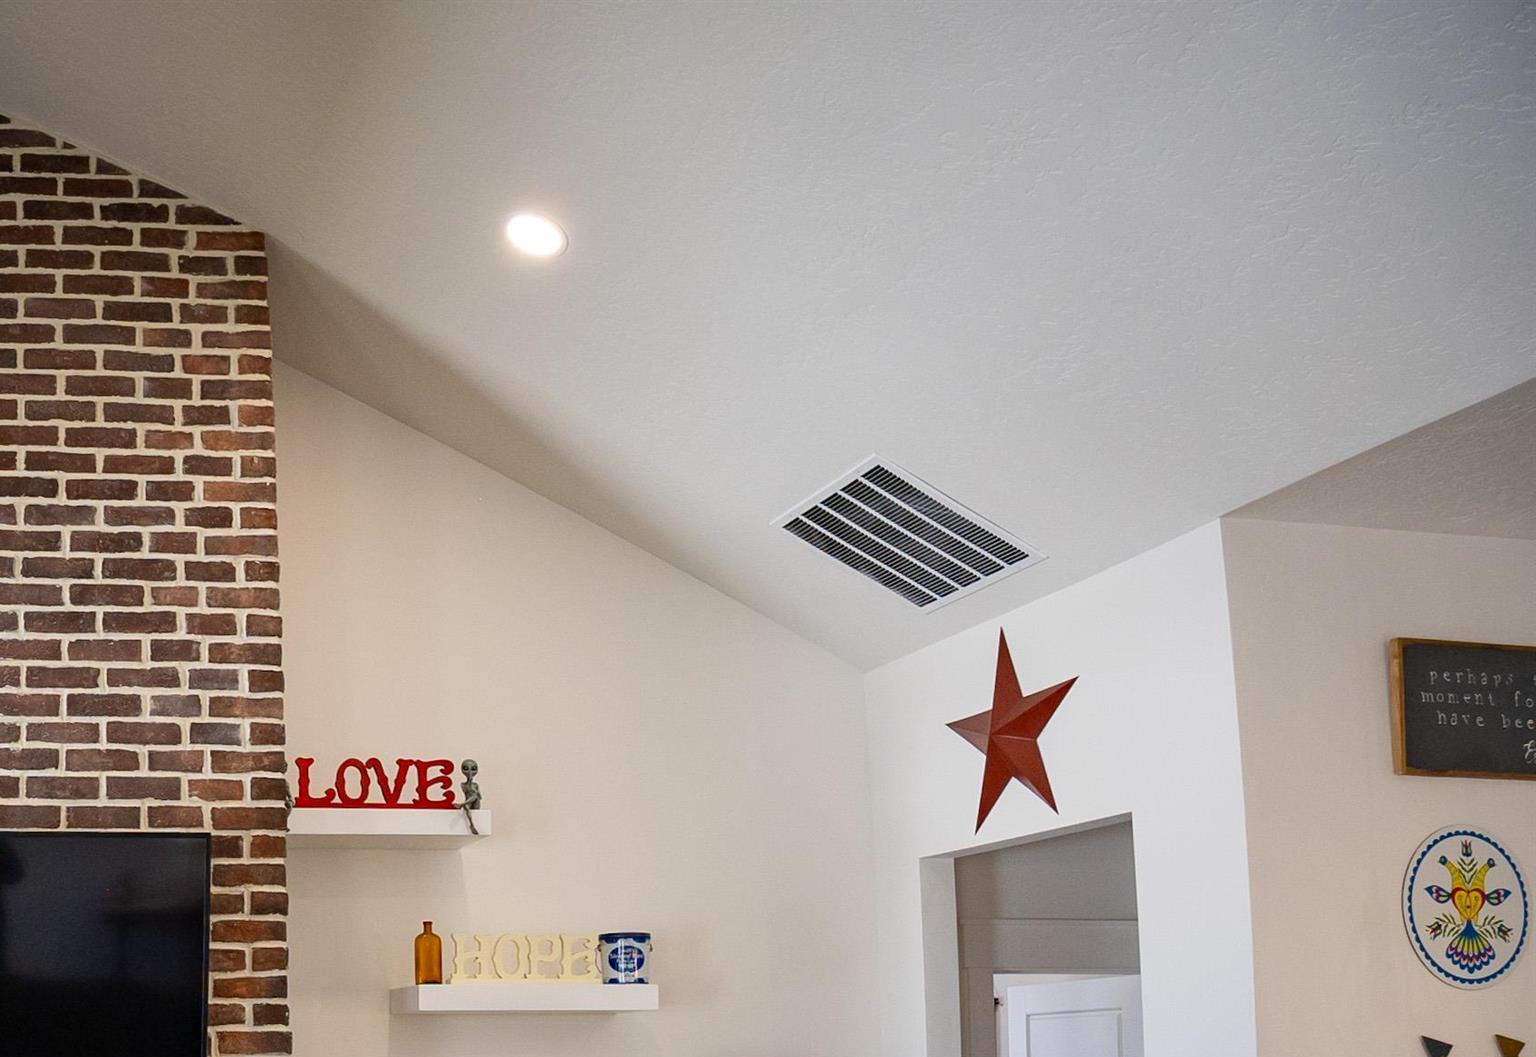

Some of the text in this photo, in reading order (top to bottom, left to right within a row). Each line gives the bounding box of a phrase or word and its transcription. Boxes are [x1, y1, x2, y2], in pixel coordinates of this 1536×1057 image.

[1429, 668, 1513, 688] perhaps
[1421, 691, 1496, 706] moment
[1435, 710, 1485, 727] have
[294, 757, 457, 808] LOVE
[446, 932, 602, 983] HOPE
